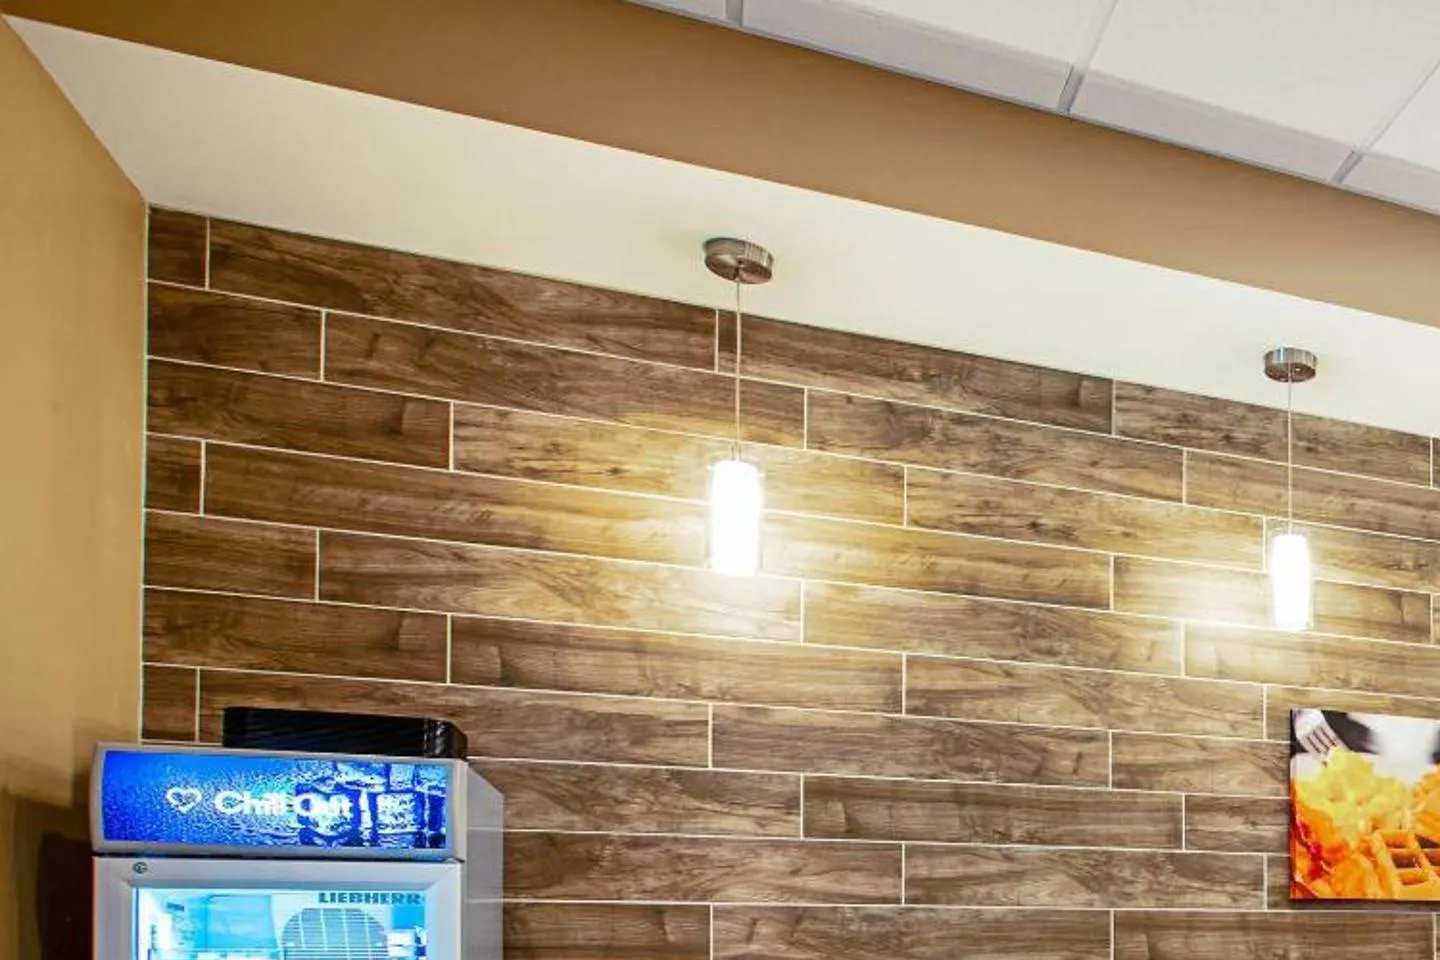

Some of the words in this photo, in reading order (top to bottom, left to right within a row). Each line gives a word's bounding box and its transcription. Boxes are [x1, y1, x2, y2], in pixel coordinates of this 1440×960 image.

[214, 788, 287, 816] Chill
[293, 791, 353, 818] Out
[318, 891, 421, 905] LIEBHERR
